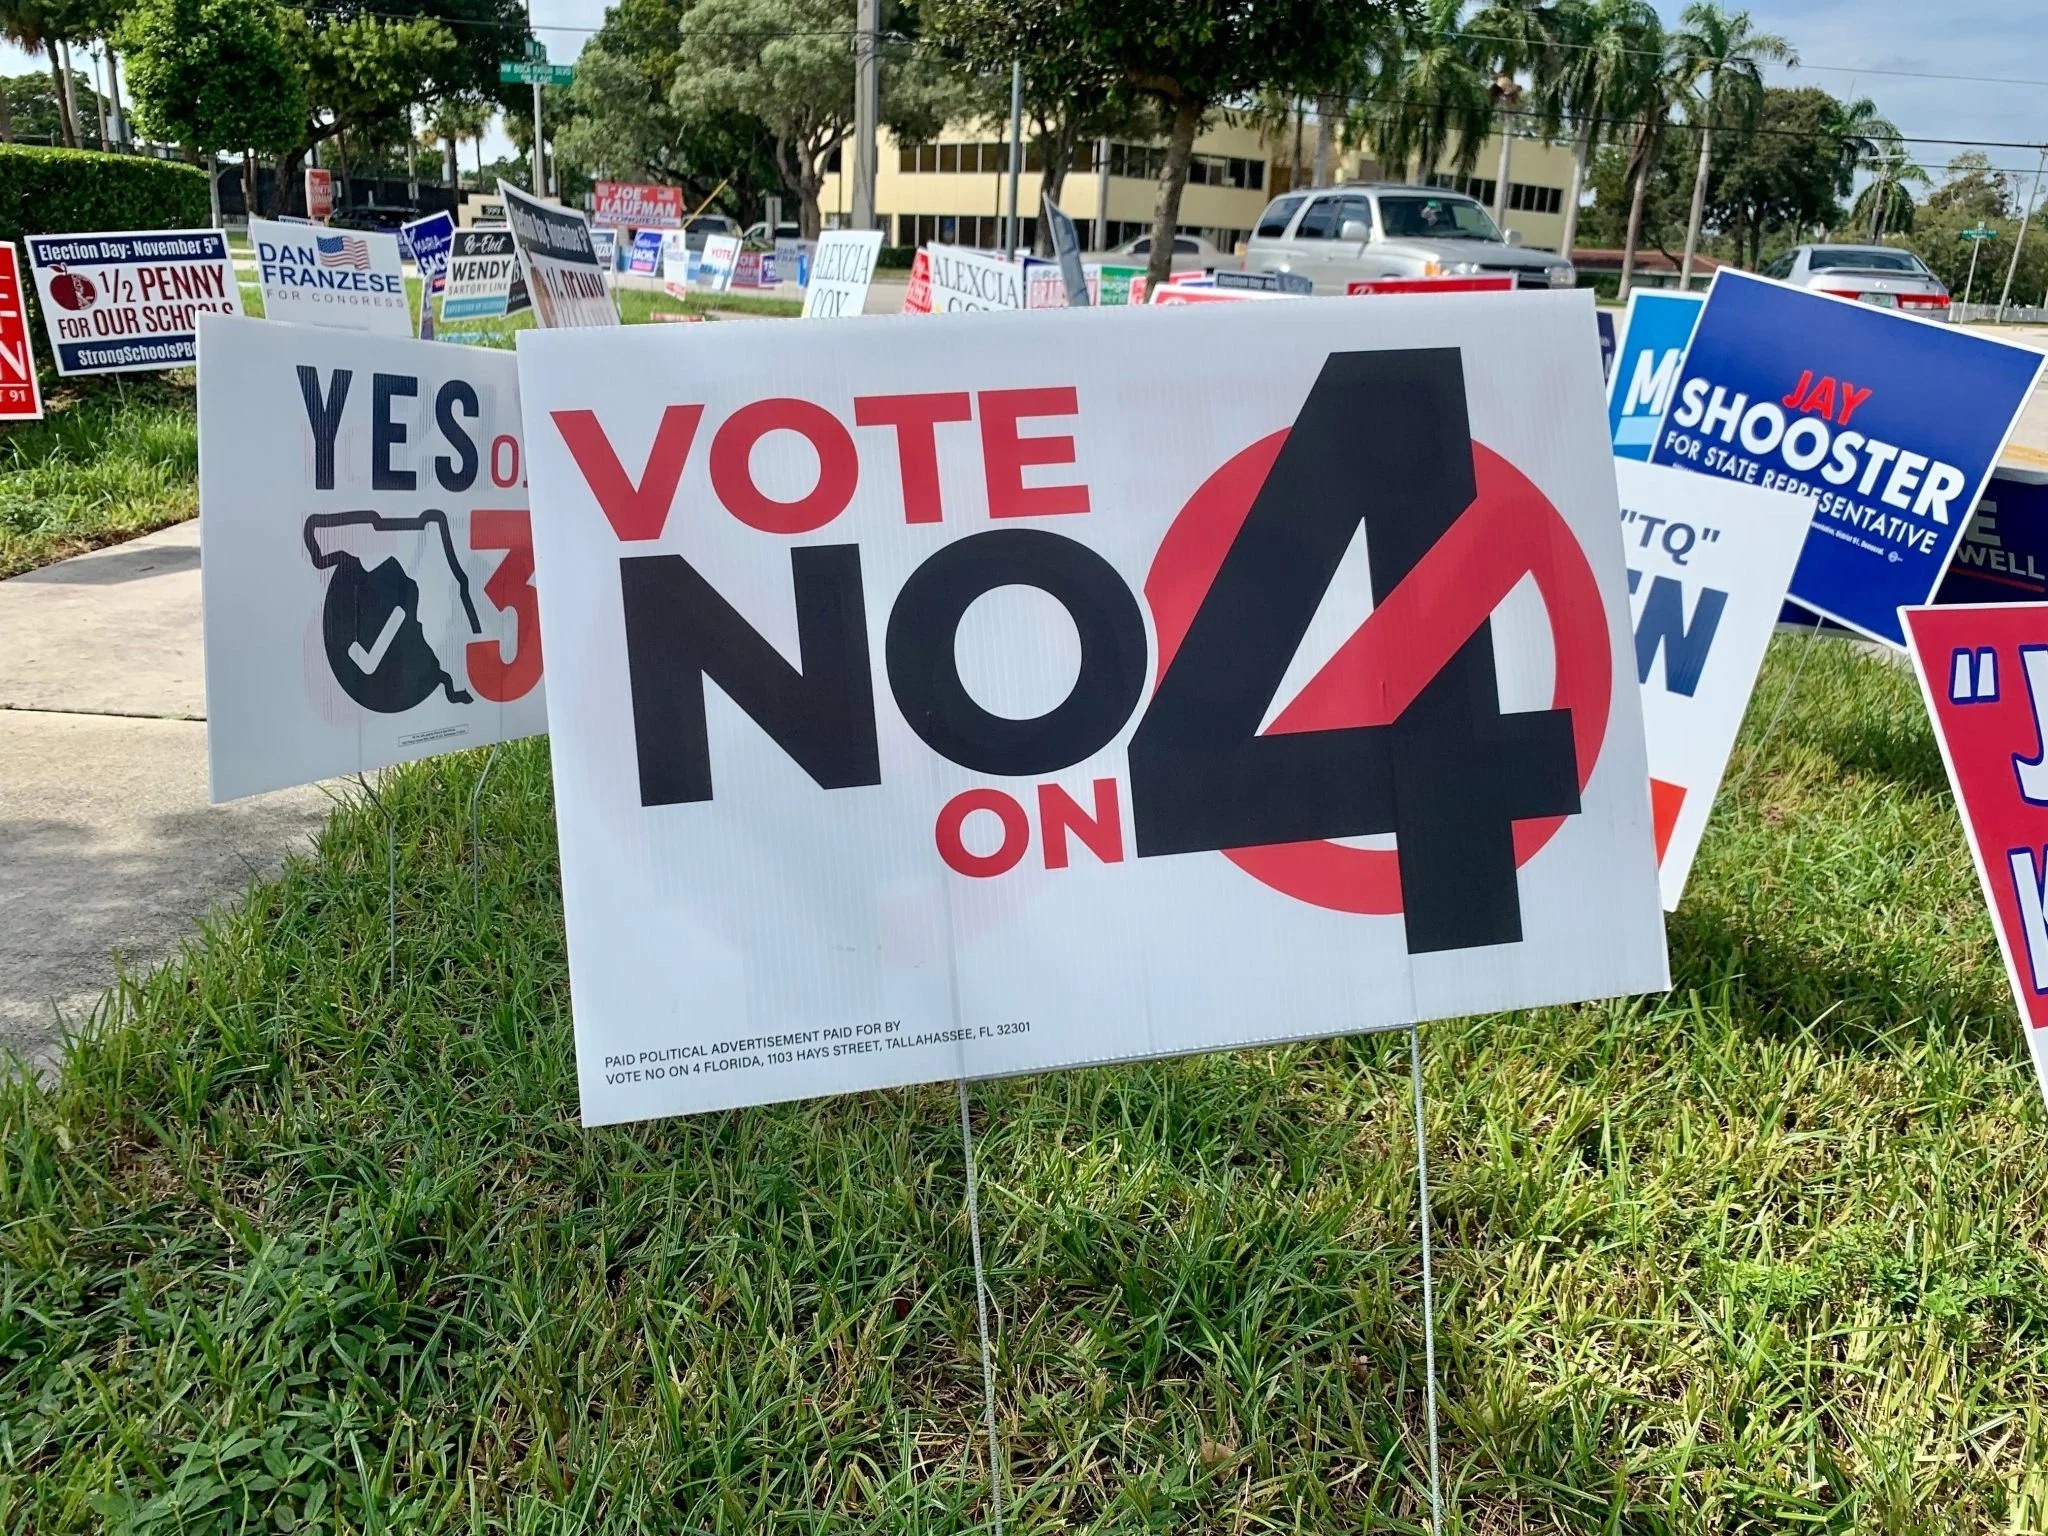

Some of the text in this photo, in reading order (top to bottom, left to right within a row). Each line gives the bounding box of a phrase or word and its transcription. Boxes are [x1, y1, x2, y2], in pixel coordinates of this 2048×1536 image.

[600, 198, 676, 217] KAUFMAN
[39, 243, 99, 261] Election
[100, 241, 131, 259] Day:
[132, 239, 201, 257] November
[258, 242, 316, 266] DAN
[452, 260, 511, 282] WENDY
[813, 243, 872, 284] ALEXCIA
[137, 264, 226, 302] PENNY
[262, 264, 402, 294] FRANZESE
[266, 288, 404, 308] FOR CONGRESS
[933, 255, 1019, 309] ALEXCIA
[57, 317, 92, 340] FOR
[92, 307, 141, 336] OUR
[9, 389, 27, 402] 91
[1782, 369, 1872, 425] JAY
[296, 365, 479, 492] YES
[1673, 377, 1965, 526] SHOOSTER
[550, 386, 1091, 541] VOTE
[1664, 430, 1939, 556] FOR STATE REPRESENTATIVE
[466, 509, 544, 702] 3
[619, 528, 1148, 806] NO
[1128, 346, 1582, 954] 4
[935, 777, 1125, 878] ON
[605, 1020, 901, 1068] PAID POLITICAL ADVERTISEMENT PAID FOR BY
[606, 1021, 1031, 1085] VOTE NO ON 4 FLORIDA, 1103 HAYS STREET, TALLAHASSEE, FL 32301
